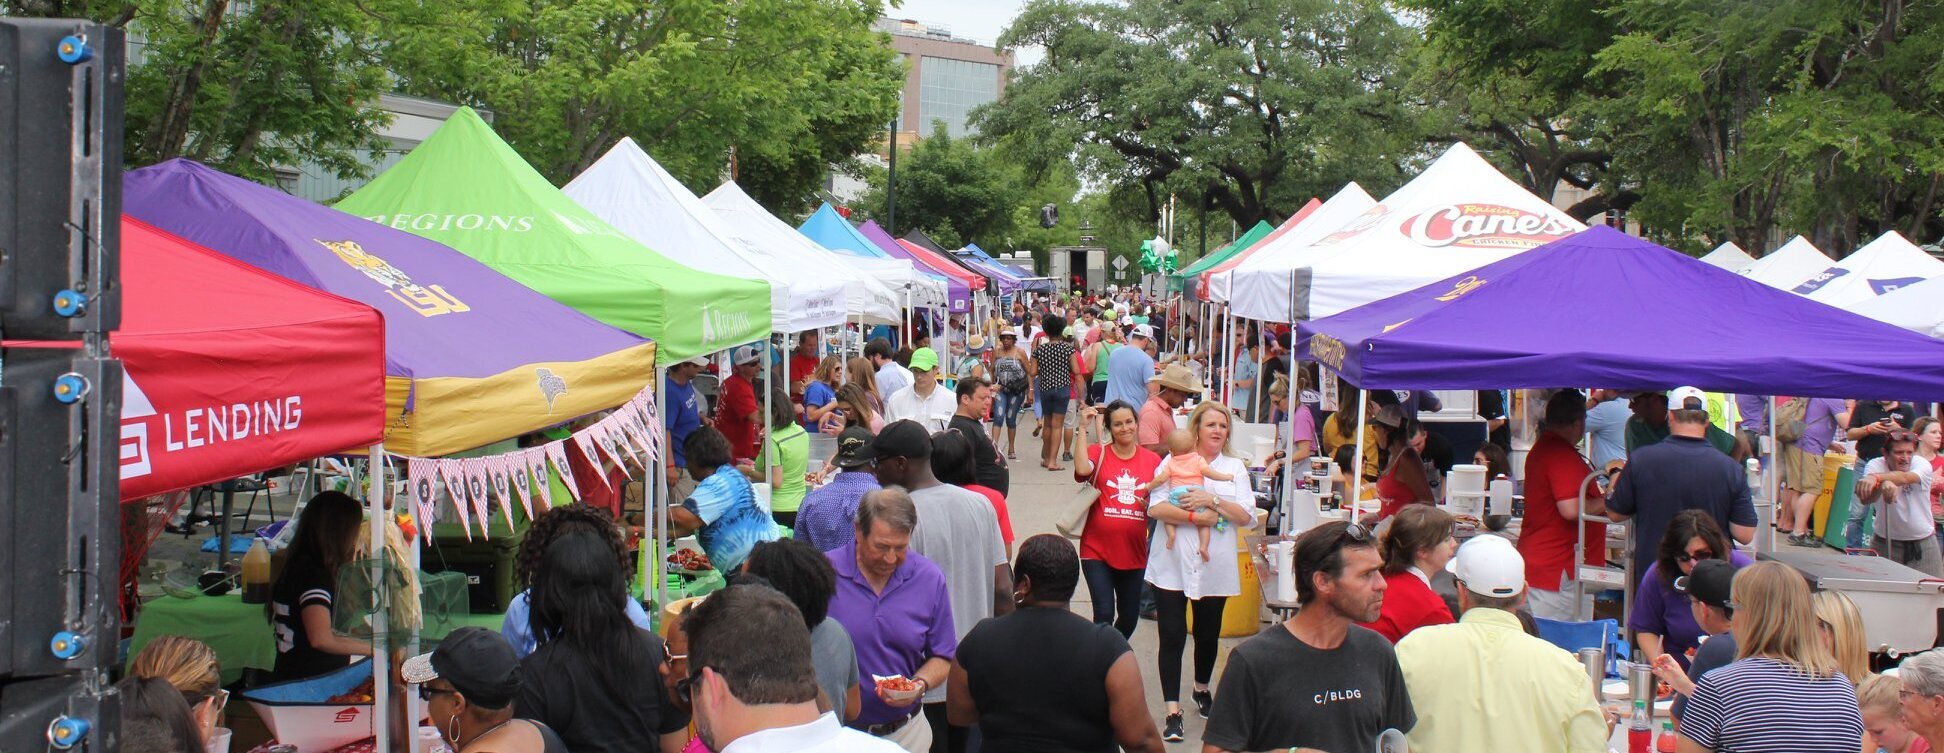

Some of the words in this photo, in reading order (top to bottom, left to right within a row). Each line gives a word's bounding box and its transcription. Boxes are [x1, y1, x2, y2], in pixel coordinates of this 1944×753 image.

[1411, 203, 1577, 248] Cane's
[1464, 205, 1521, 217] Raising
[164, 395, 303, 453] LENDING
[1313, 688, 1362, 705] C/BLDG
